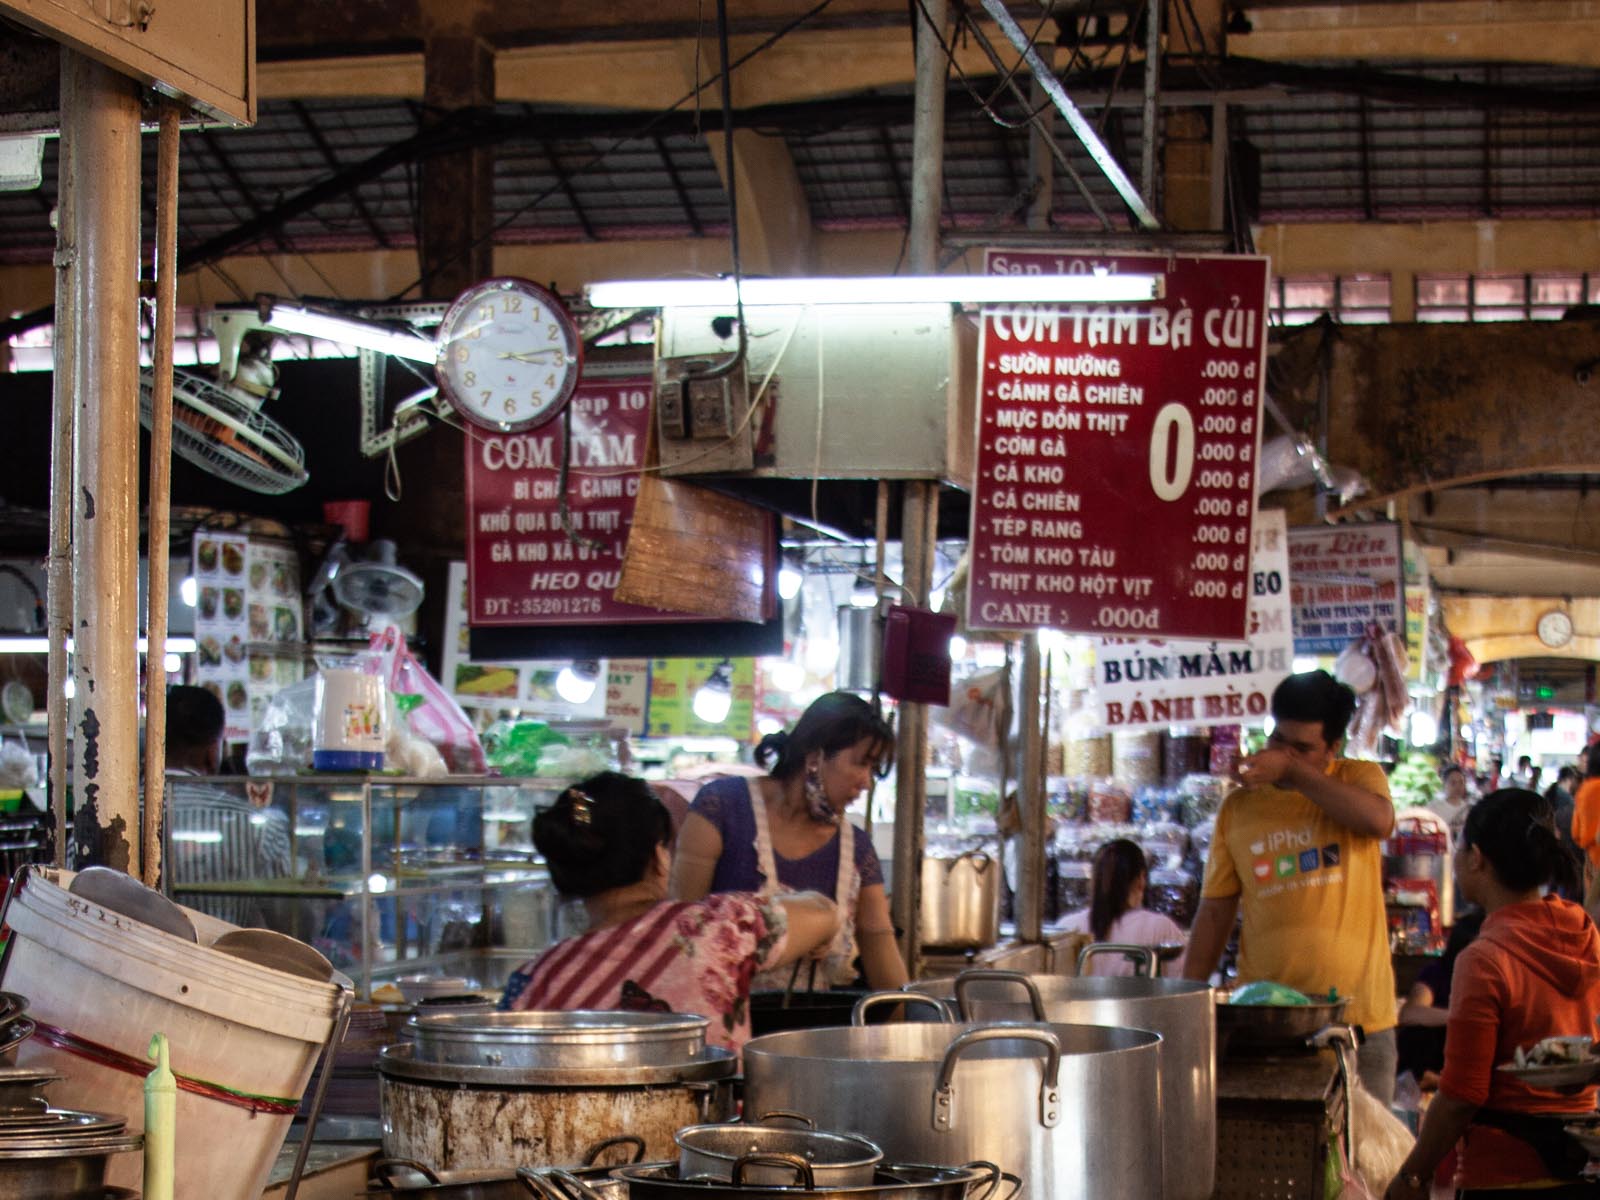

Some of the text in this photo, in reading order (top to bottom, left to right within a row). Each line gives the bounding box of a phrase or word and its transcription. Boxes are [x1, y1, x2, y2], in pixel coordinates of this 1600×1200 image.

[502, 297, 522, 314] 12
[532, 306, 540, 322] 1
[547, 324, 559, 341] 2
[1148, 297, 1193, 350] BÀ
[1203, 295, 1256, 348] CỦI
[552, 349, 564, 367] 3
[1201, 360, 1239, 378] .000
[463, 371, 476, 388] 8
[544, 373, 556, 389] 4
[480, 391, 493, 407] 7
[531, 391, 542, 407] 5
[618, 391, 653, 411] 10
[997, 379, 1050, 402] CÁNH
[1054, 380, 1080, 403] GÀ
[1084, 383, 1143, 405] CHIÊN
[1199, 388, 1237, 406] .000
[503, 397, 517, 415] 6
[996, 409, 1037, 433] MỰC
[1086, 413, 1129, 437] THỊT
[1198, 416, 1236, 434] .000
[482, 420, 637, 470] CƠM TẤM
[995, 436, 1036, 456] CƠM
[1040, 434, 1066, 457] GÀ
[1197, 443, 1234, 461] .000
[994, 461, 1018, 482] CÁ
[1024, 466, 1064, 484] KHO
[1195, 470, 1233, 488] .000
[992, 488, 1017, 509] CÁ
[1022, 490, 1080, 511] CHIÊN
[1194, 498, 1231, 516] .000
[515, 513, 546, 534] QUA
[551, 510, 583, 531] DN
[587, 511, 620, 534] THỊT
[1031, 520, 1082, 539] RANG
[1192, 525, 1230, 543] .000
[491, 540, 512, 562] GÀ
[517, 543, 548, 562] KHO
[989, 543, 1029, 564] TÔM
[1034, 547, 1073, 566] KHO
[1078, 545, 1115, 567] TÀU
[1190, 552, 1228, 570] .000
[530, 572, 580, 590] HEO
[989, 572, 1030, 595] THỊT
[1036, 574, 1075, 593] KHO
[1079, 574, 1117, 598] HỘT
[1123, 578, 1152, 600] VỊT
[1189, 580, 1227, 598] .000
[980, 602, 1051, 624] CANH
[1103, 649, 1168, 684] BÚN
[1105, 684, 1267, 725] BÁNH BÈO
